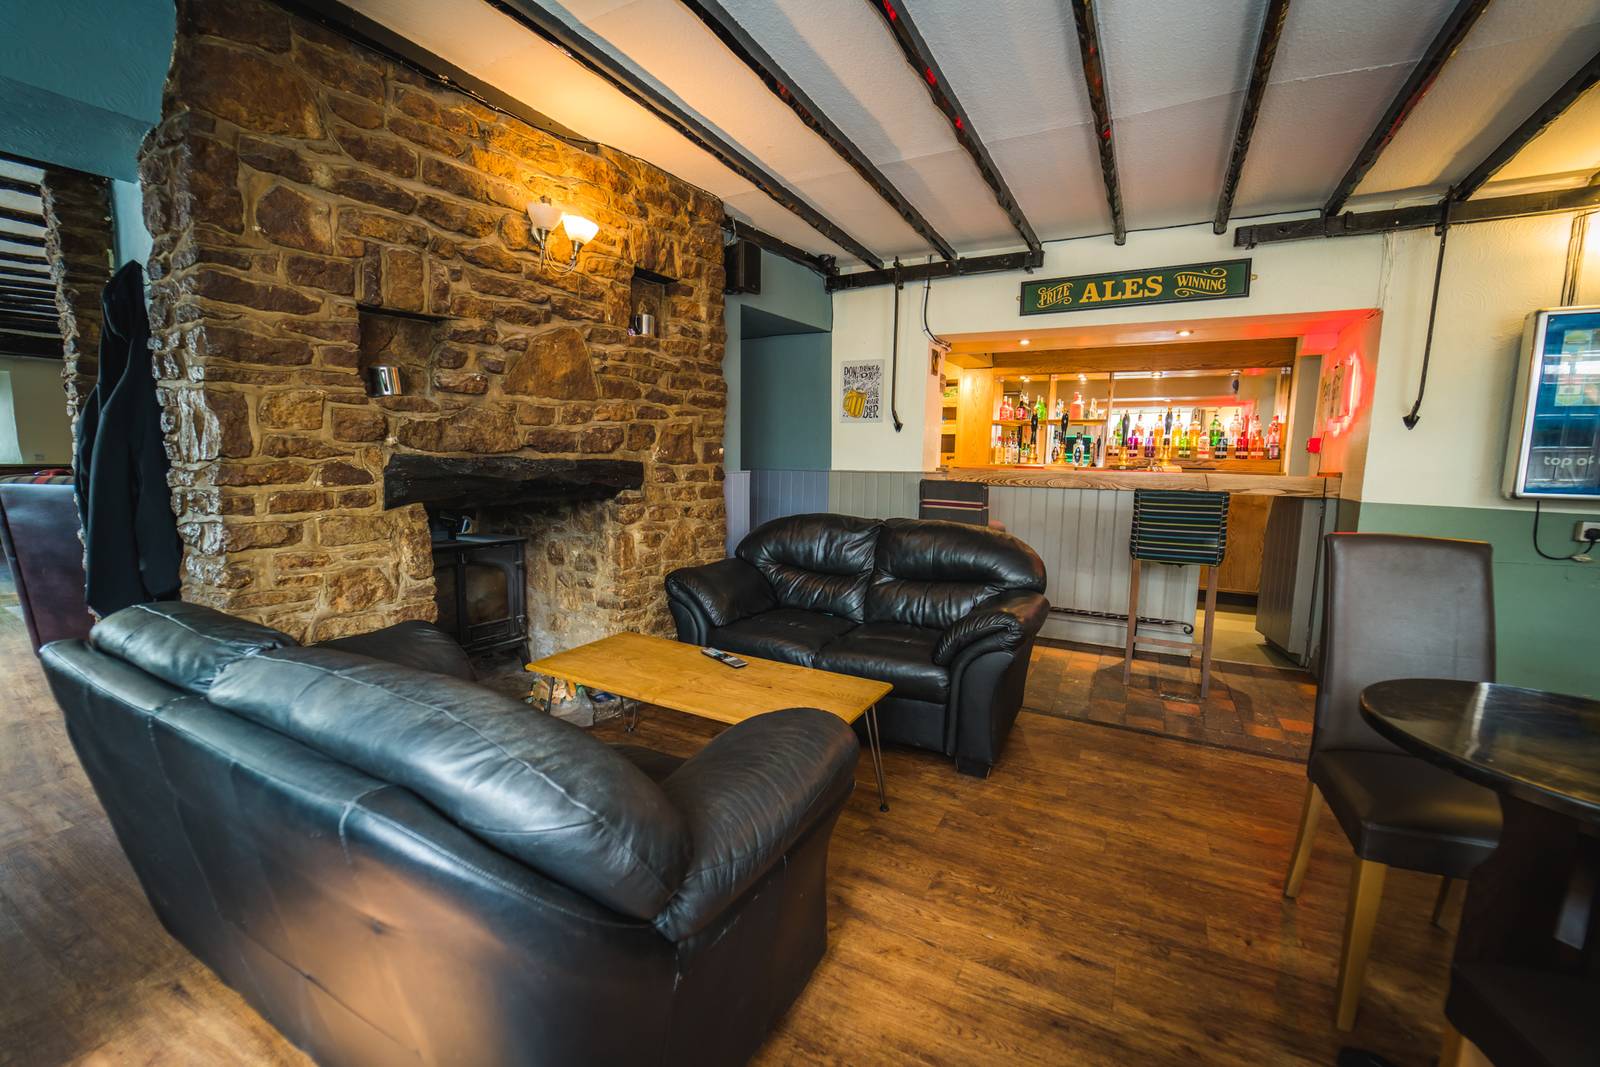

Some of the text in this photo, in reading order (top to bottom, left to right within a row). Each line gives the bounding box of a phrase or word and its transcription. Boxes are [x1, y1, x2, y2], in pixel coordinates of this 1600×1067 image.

[1038, 275, 1226, 305] PRIZE ALES WINNING
[1544, 455, 1594, 468] top of
